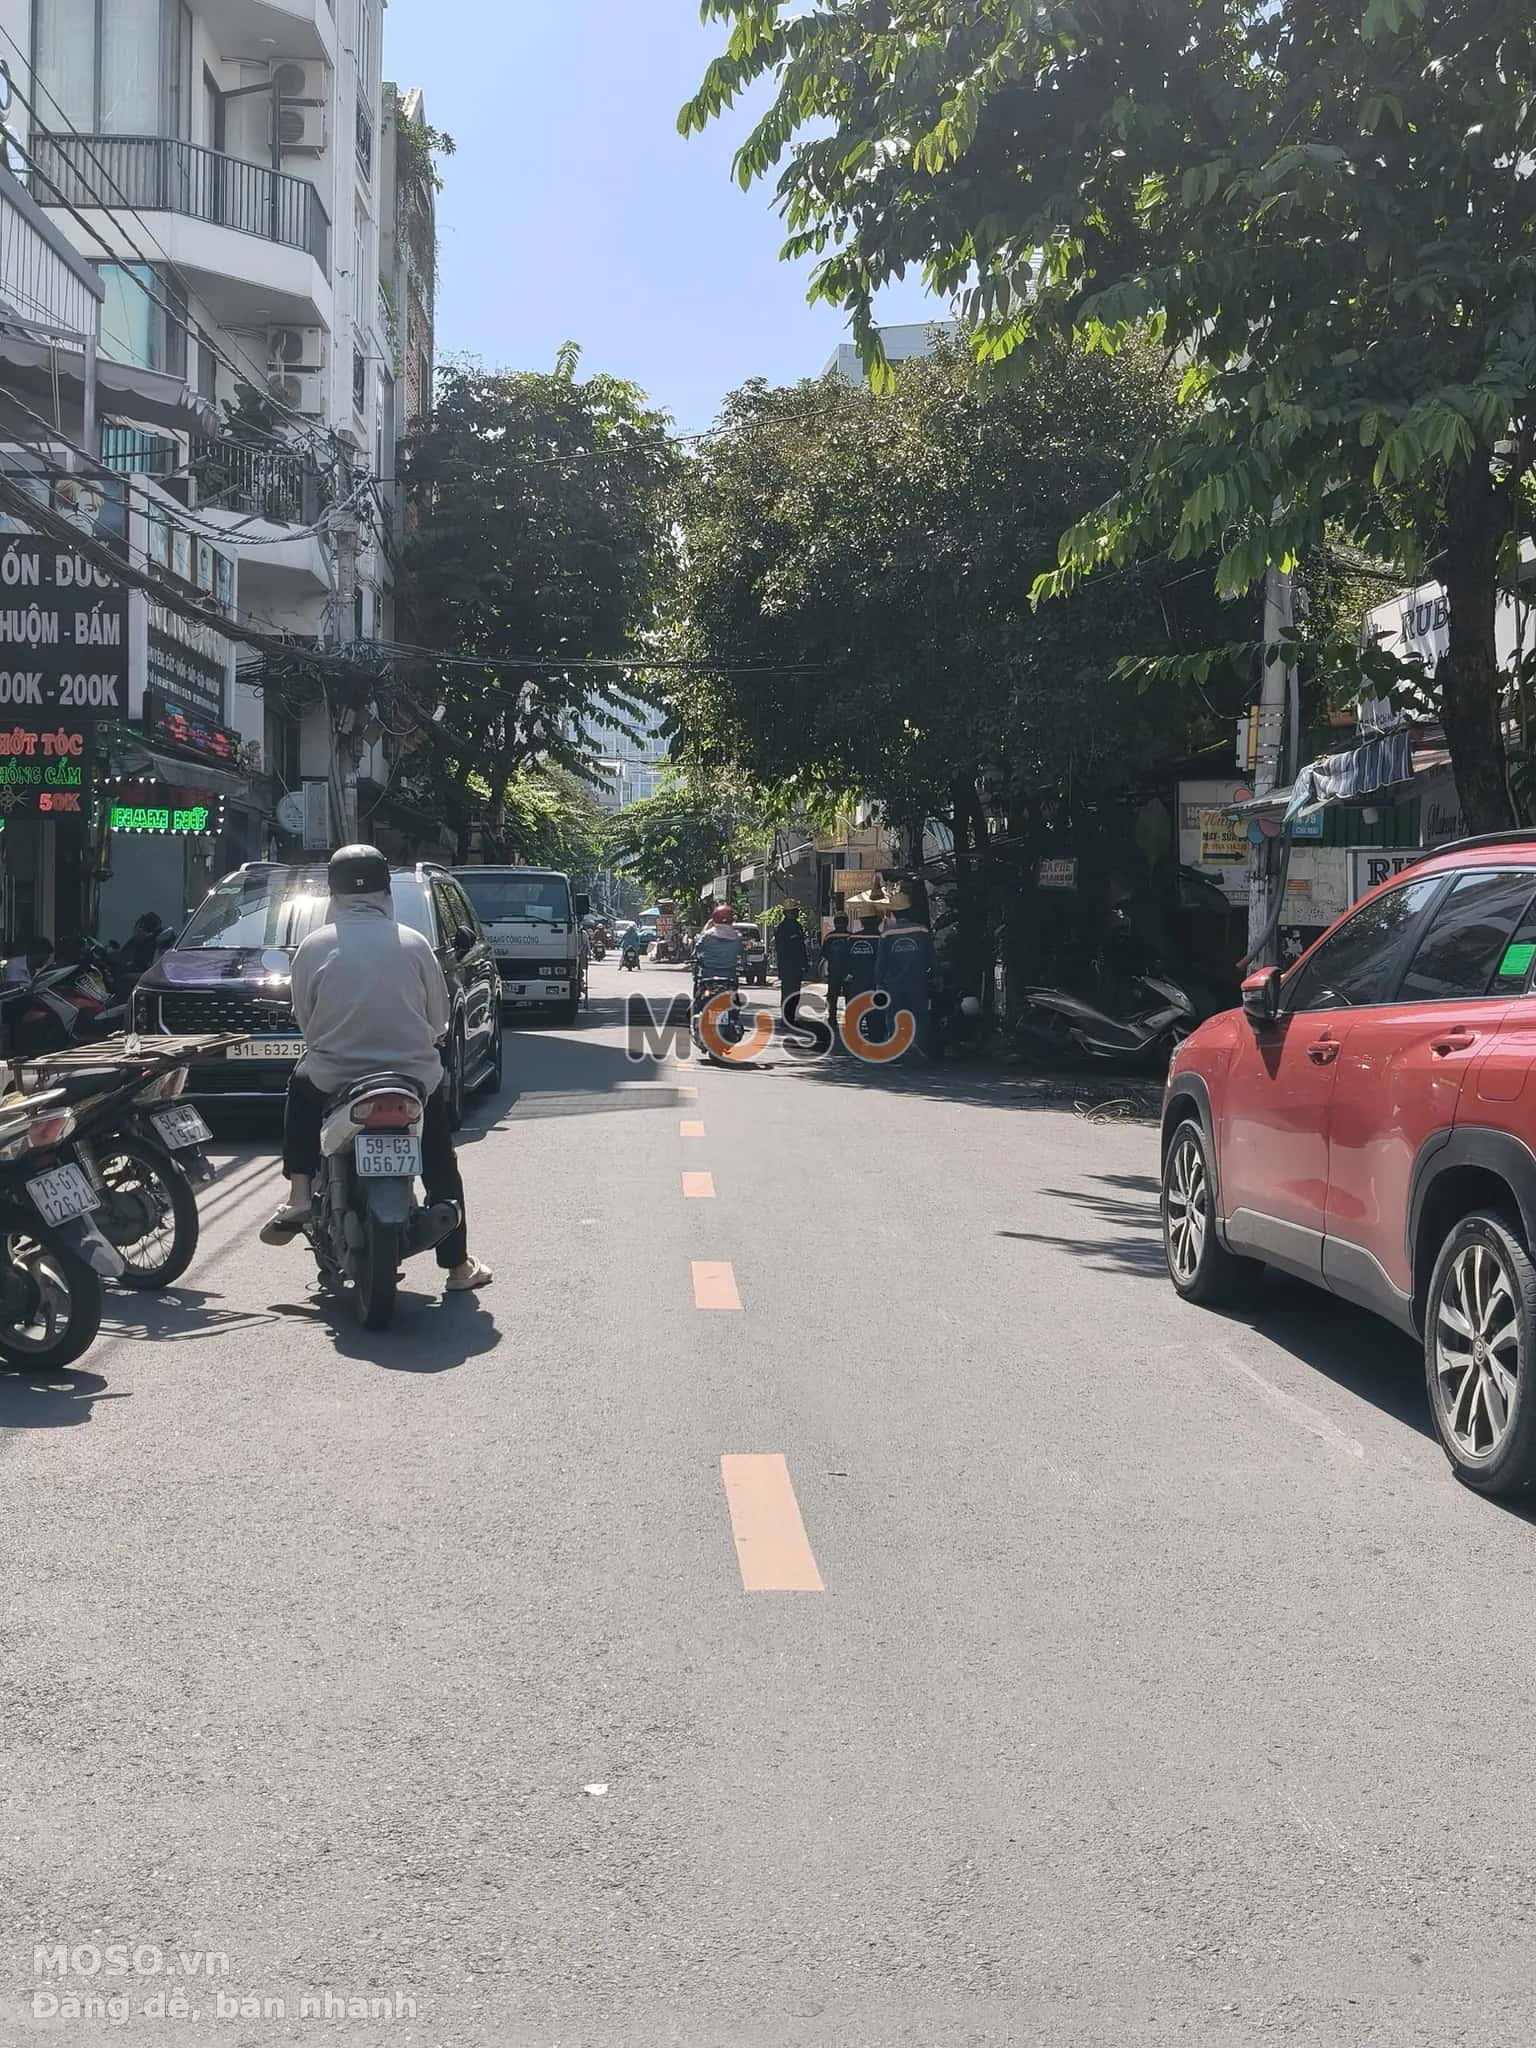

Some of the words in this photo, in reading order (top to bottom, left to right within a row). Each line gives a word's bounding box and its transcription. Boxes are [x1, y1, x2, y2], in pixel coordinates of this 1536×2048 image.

[75, 600, 120, 645] BẤM
[59, 673, 119, 706] 200K
[41, 727, 83, 755] TÓC
[39, 792, 80, 812] 50K
[113, 807, 169, 829] NAM
[174, 806, 208, 830] NỮ
[366, 1138, 411, 1154] 59-G3
[362, 1156, 416, 1173] 056.77
[36, 1171, 78, 1199] 73-G1
